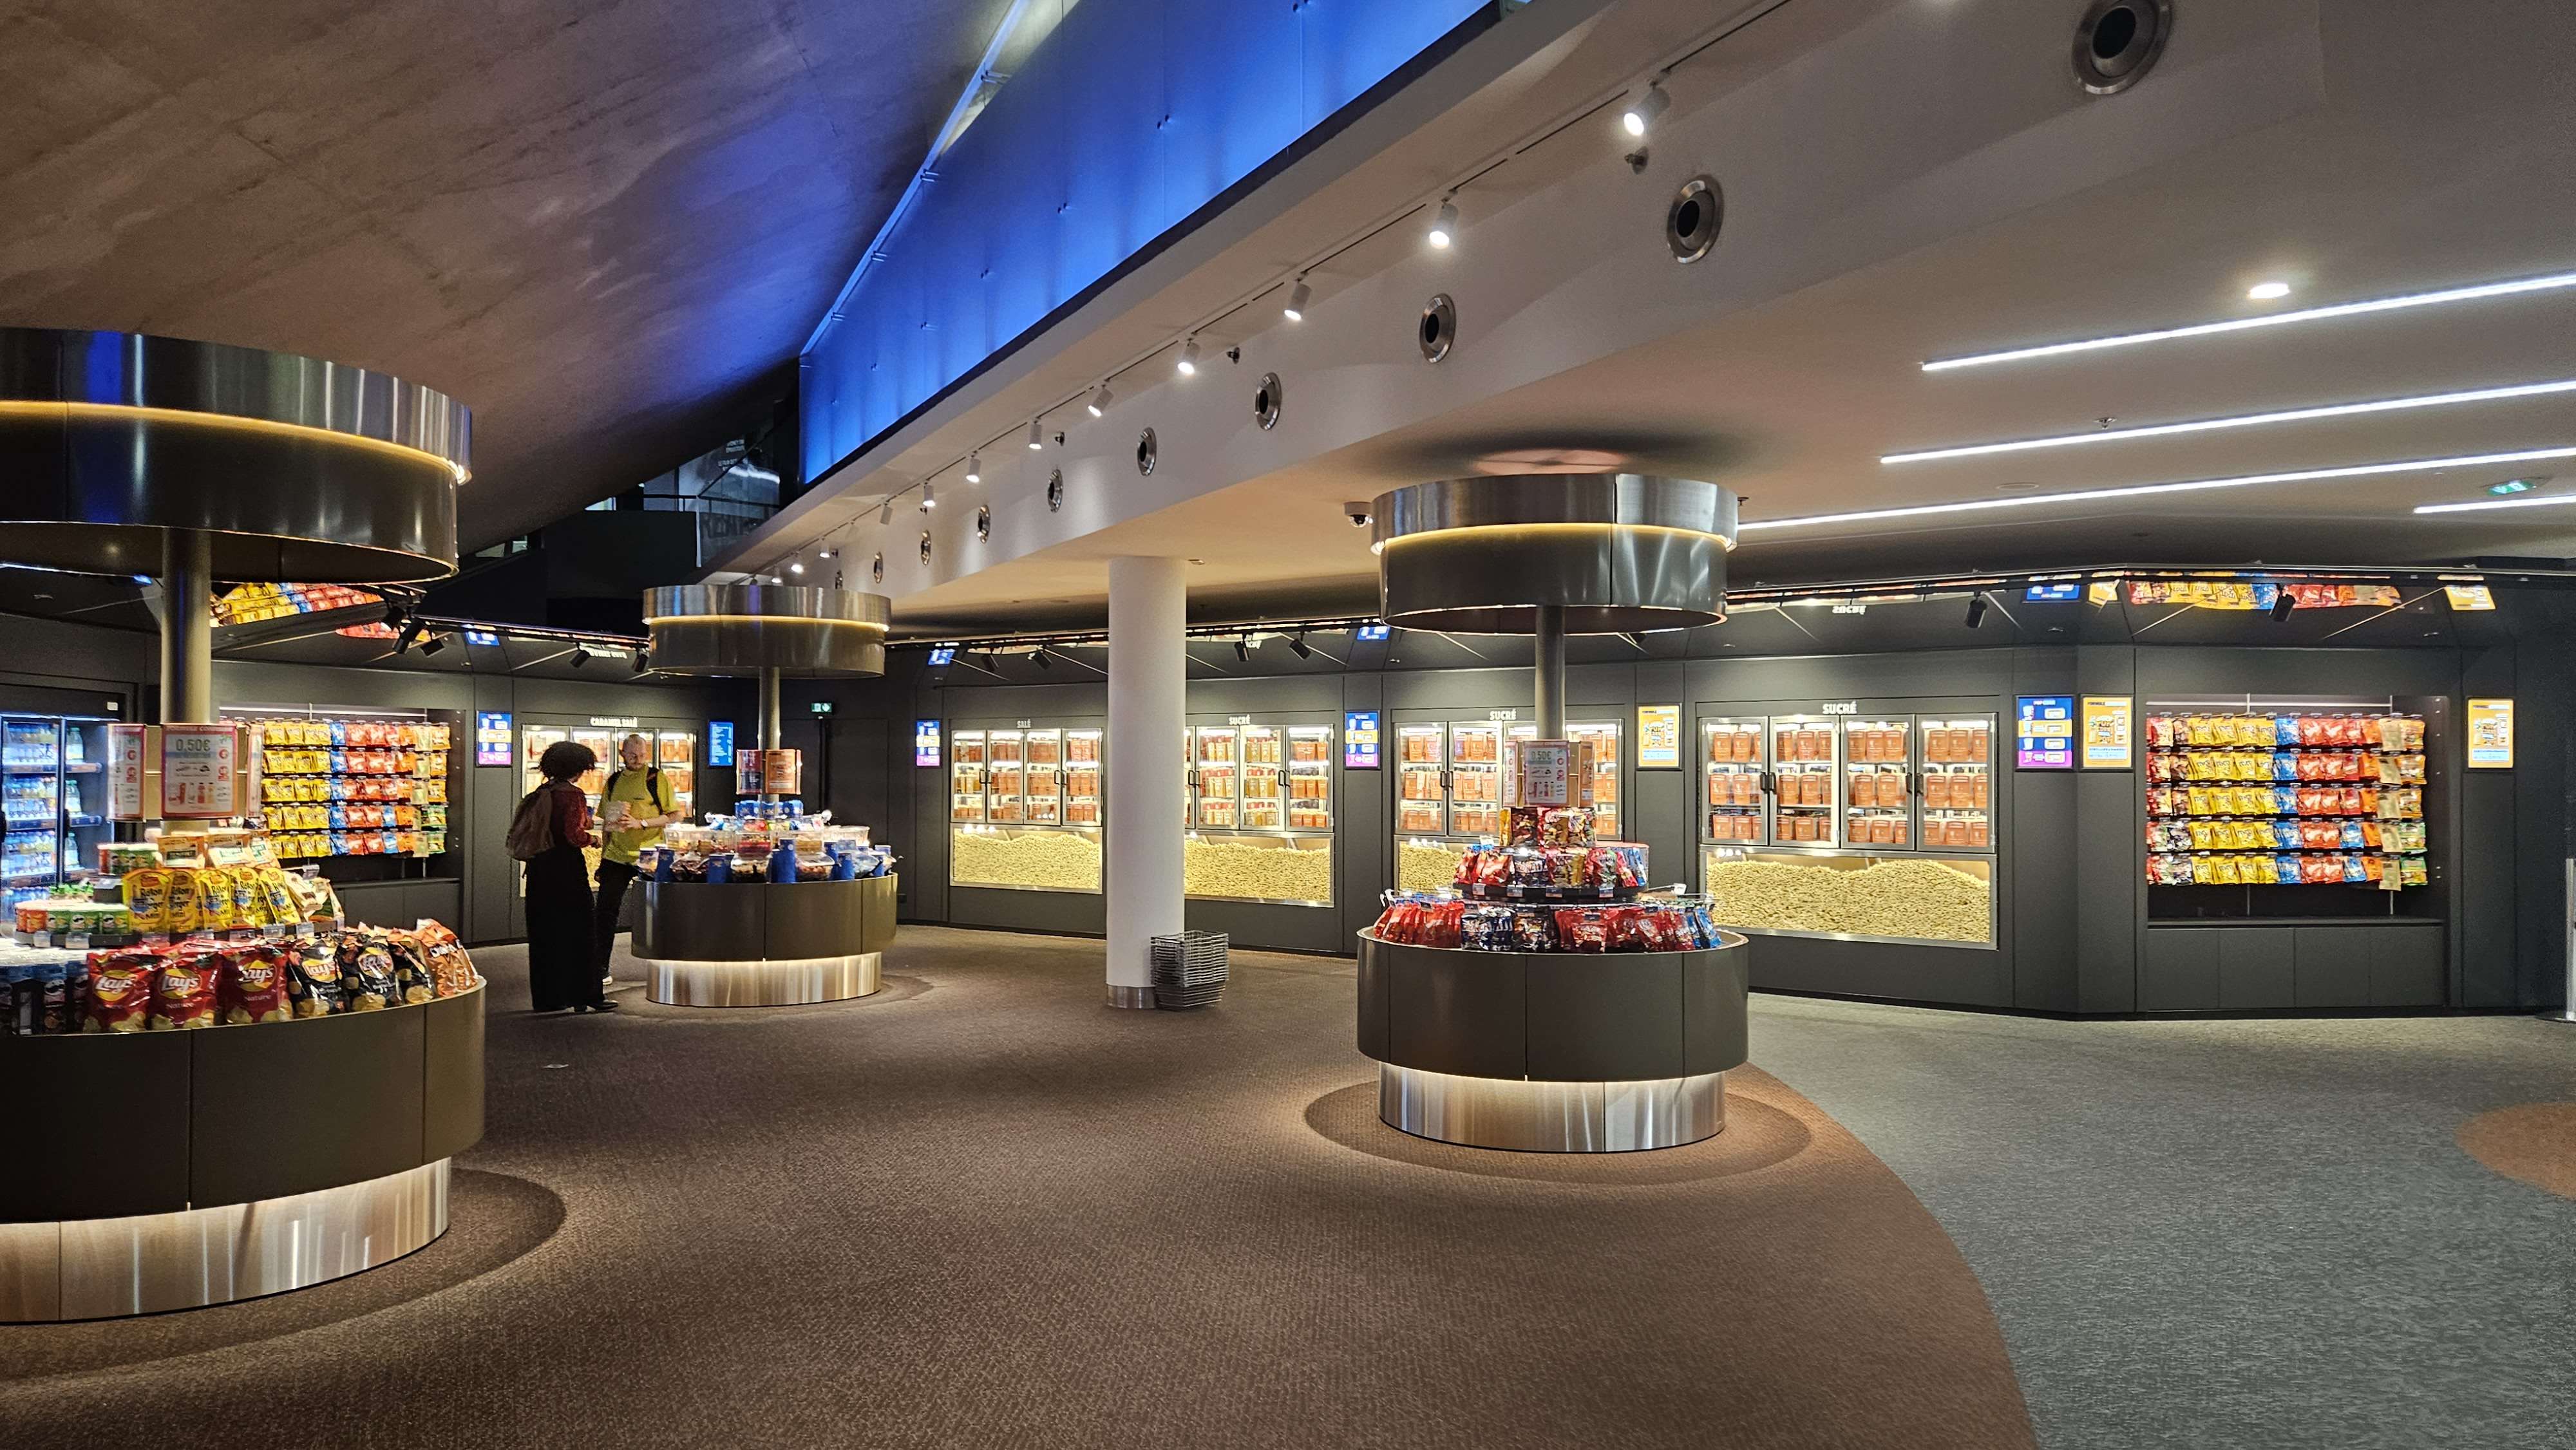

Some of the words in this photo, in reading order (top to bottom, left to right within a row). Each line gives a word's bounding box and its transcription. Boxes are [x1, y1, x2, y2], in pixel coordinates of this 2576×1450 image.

[1490, 708, 1517, 720] SUCRÉ
[1822, 701, 1857, 715] SUCRÉ
[1017, 719, 1031, 728] SALÉ
[1229, 713, 1251, 725] SUCRÉ
[304, 961, 336, 977] Lay's
[95, 975, 134, 995] Lay's
[161, 974, 198, 993] Lay's
[166, 1001, 194, 1010] Nature
